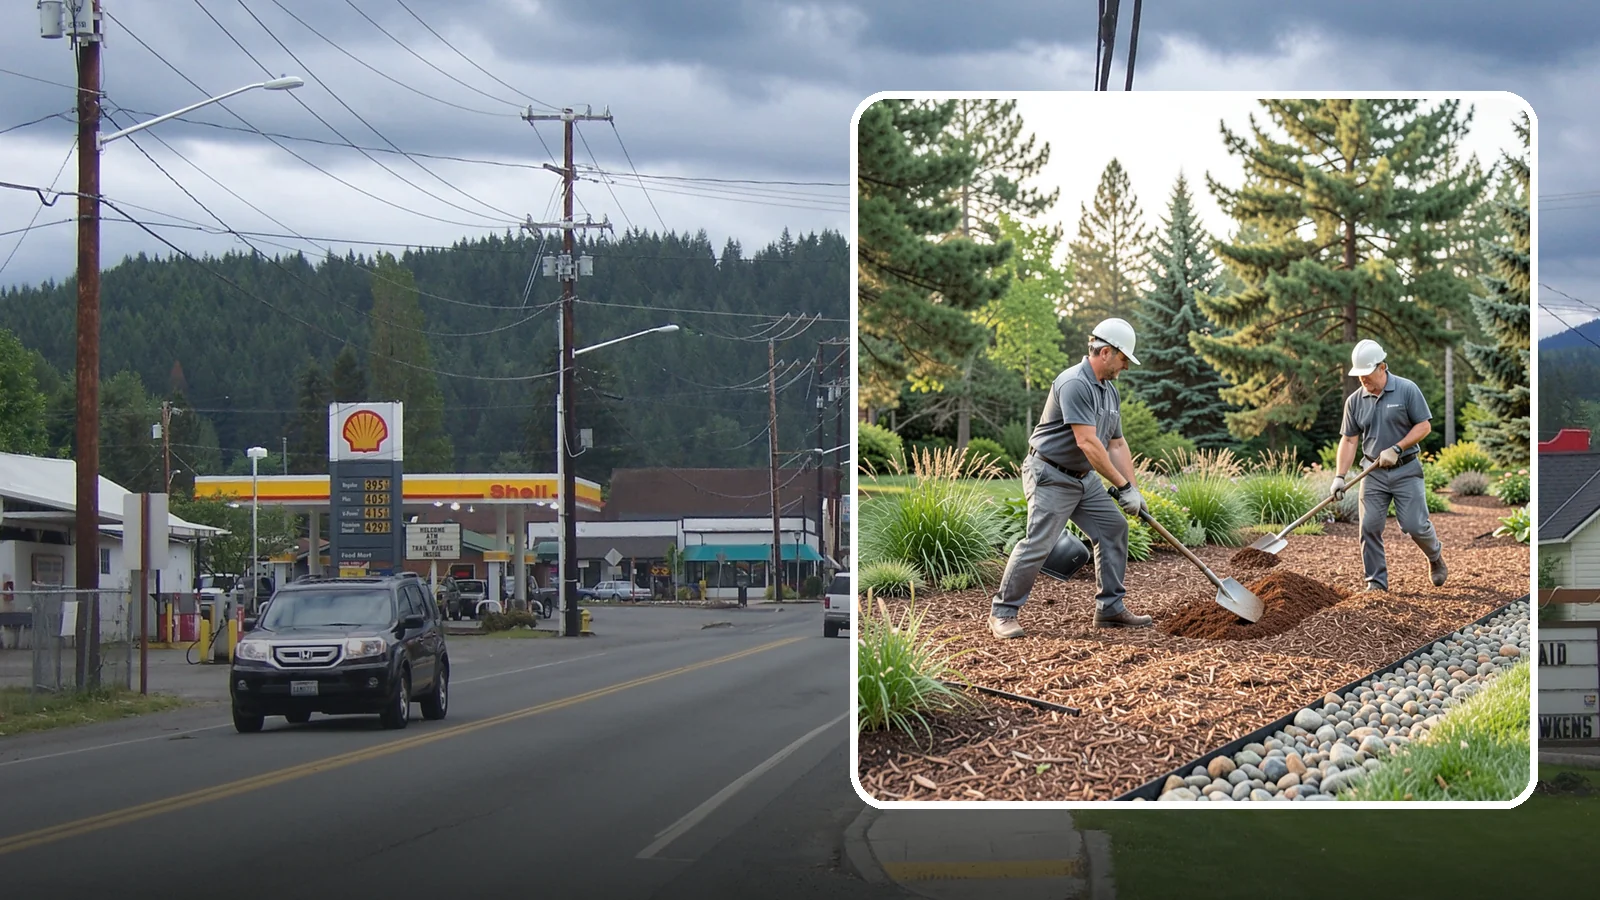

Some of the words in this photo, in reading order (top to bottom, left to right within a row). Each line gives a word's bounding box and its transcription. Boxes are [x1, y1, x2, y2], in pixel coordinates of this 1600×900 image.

[366, 480, 384, 490] 395
[490, 484, 547, 499] Shell
[366, 495, 384, 504] 405
[366, 508, 383, 517] 415
[366, 523, 384, 532] 429
